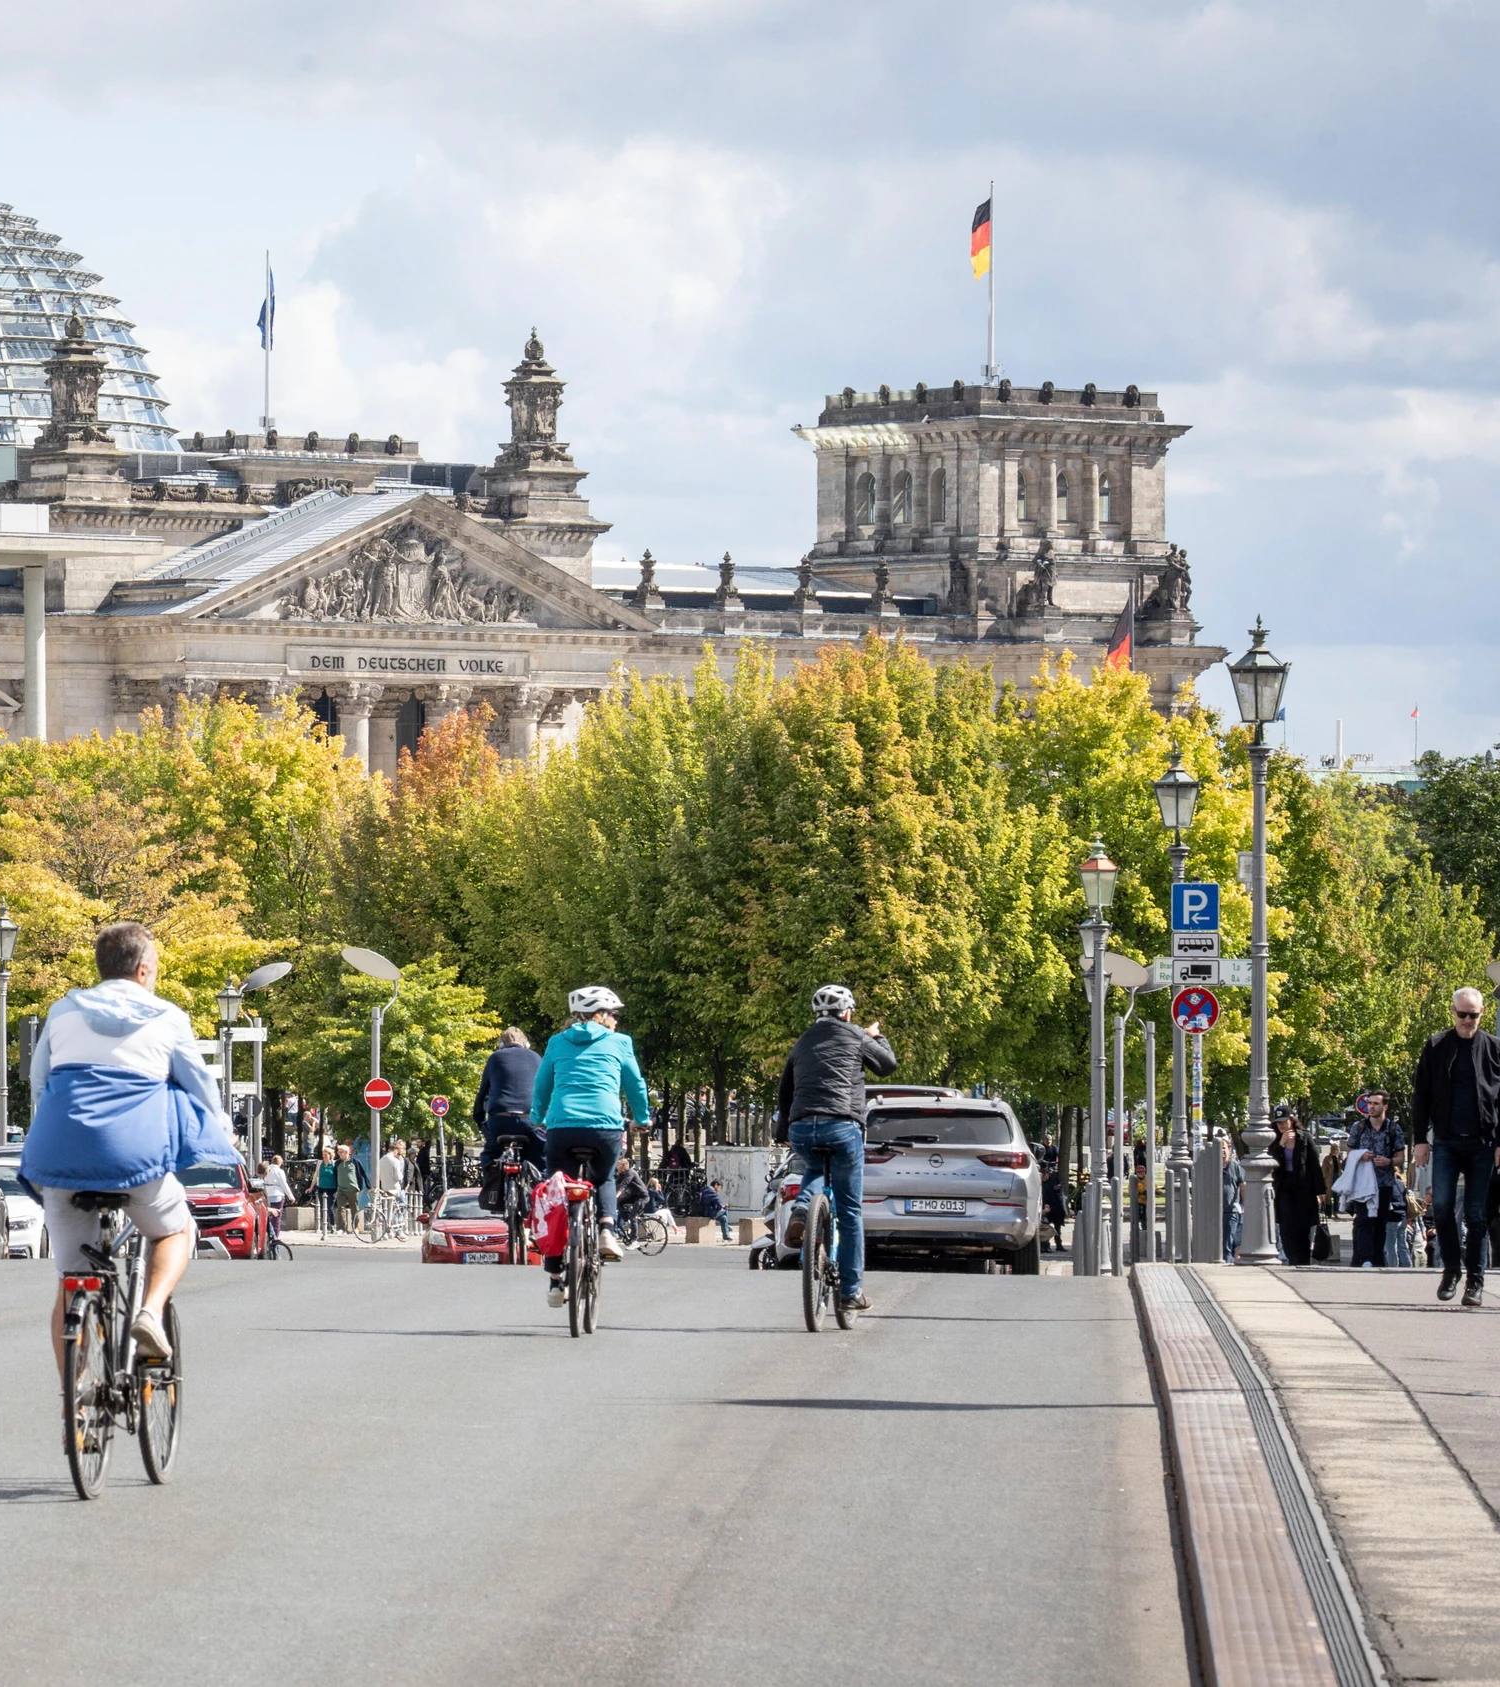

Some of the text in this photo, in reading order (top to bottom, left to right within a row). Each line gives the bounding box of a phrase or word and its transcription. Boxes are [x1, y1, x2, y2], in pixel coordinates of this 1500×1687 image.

[310, 655, 504, 673] DEM DEUTSCHEN VOLKE
[1183, 889, 1208, 925] P
[911, 1200, 965, 1210] F MQ 6013
